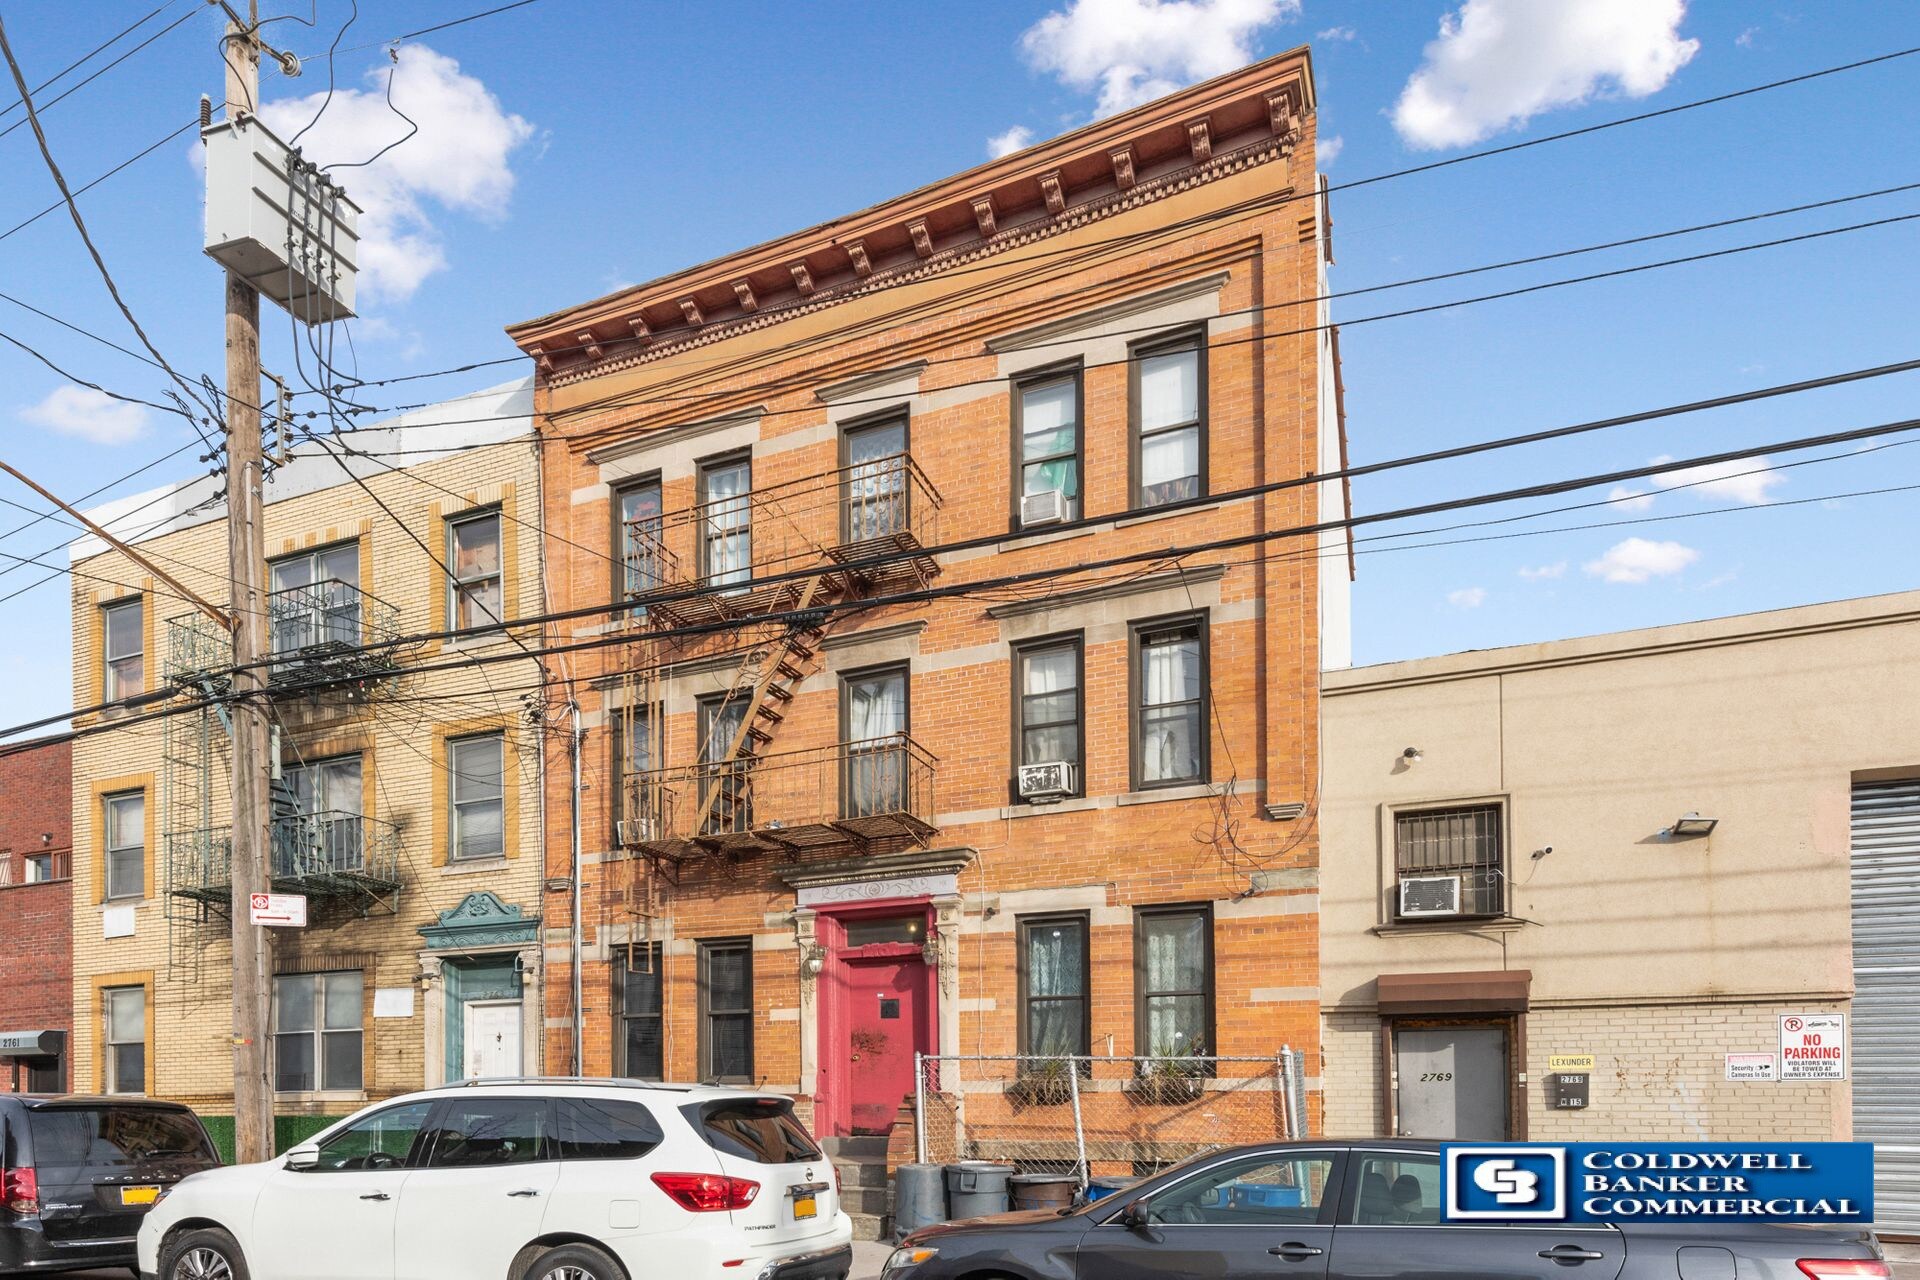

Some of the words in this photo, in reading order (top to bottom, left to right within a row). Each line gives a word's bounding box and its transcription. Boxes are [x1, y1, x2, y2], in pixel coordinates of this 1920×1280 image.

[2, 1037, 20, 1048] 2761
[1803, 1034, 1821, 1046] NO
[1784, 1047, 1841, 1059] PARKING
[1552, 1058, 1591, 1066] LEXUNDER
[1420, 1072, 1453, 1082] 2769
